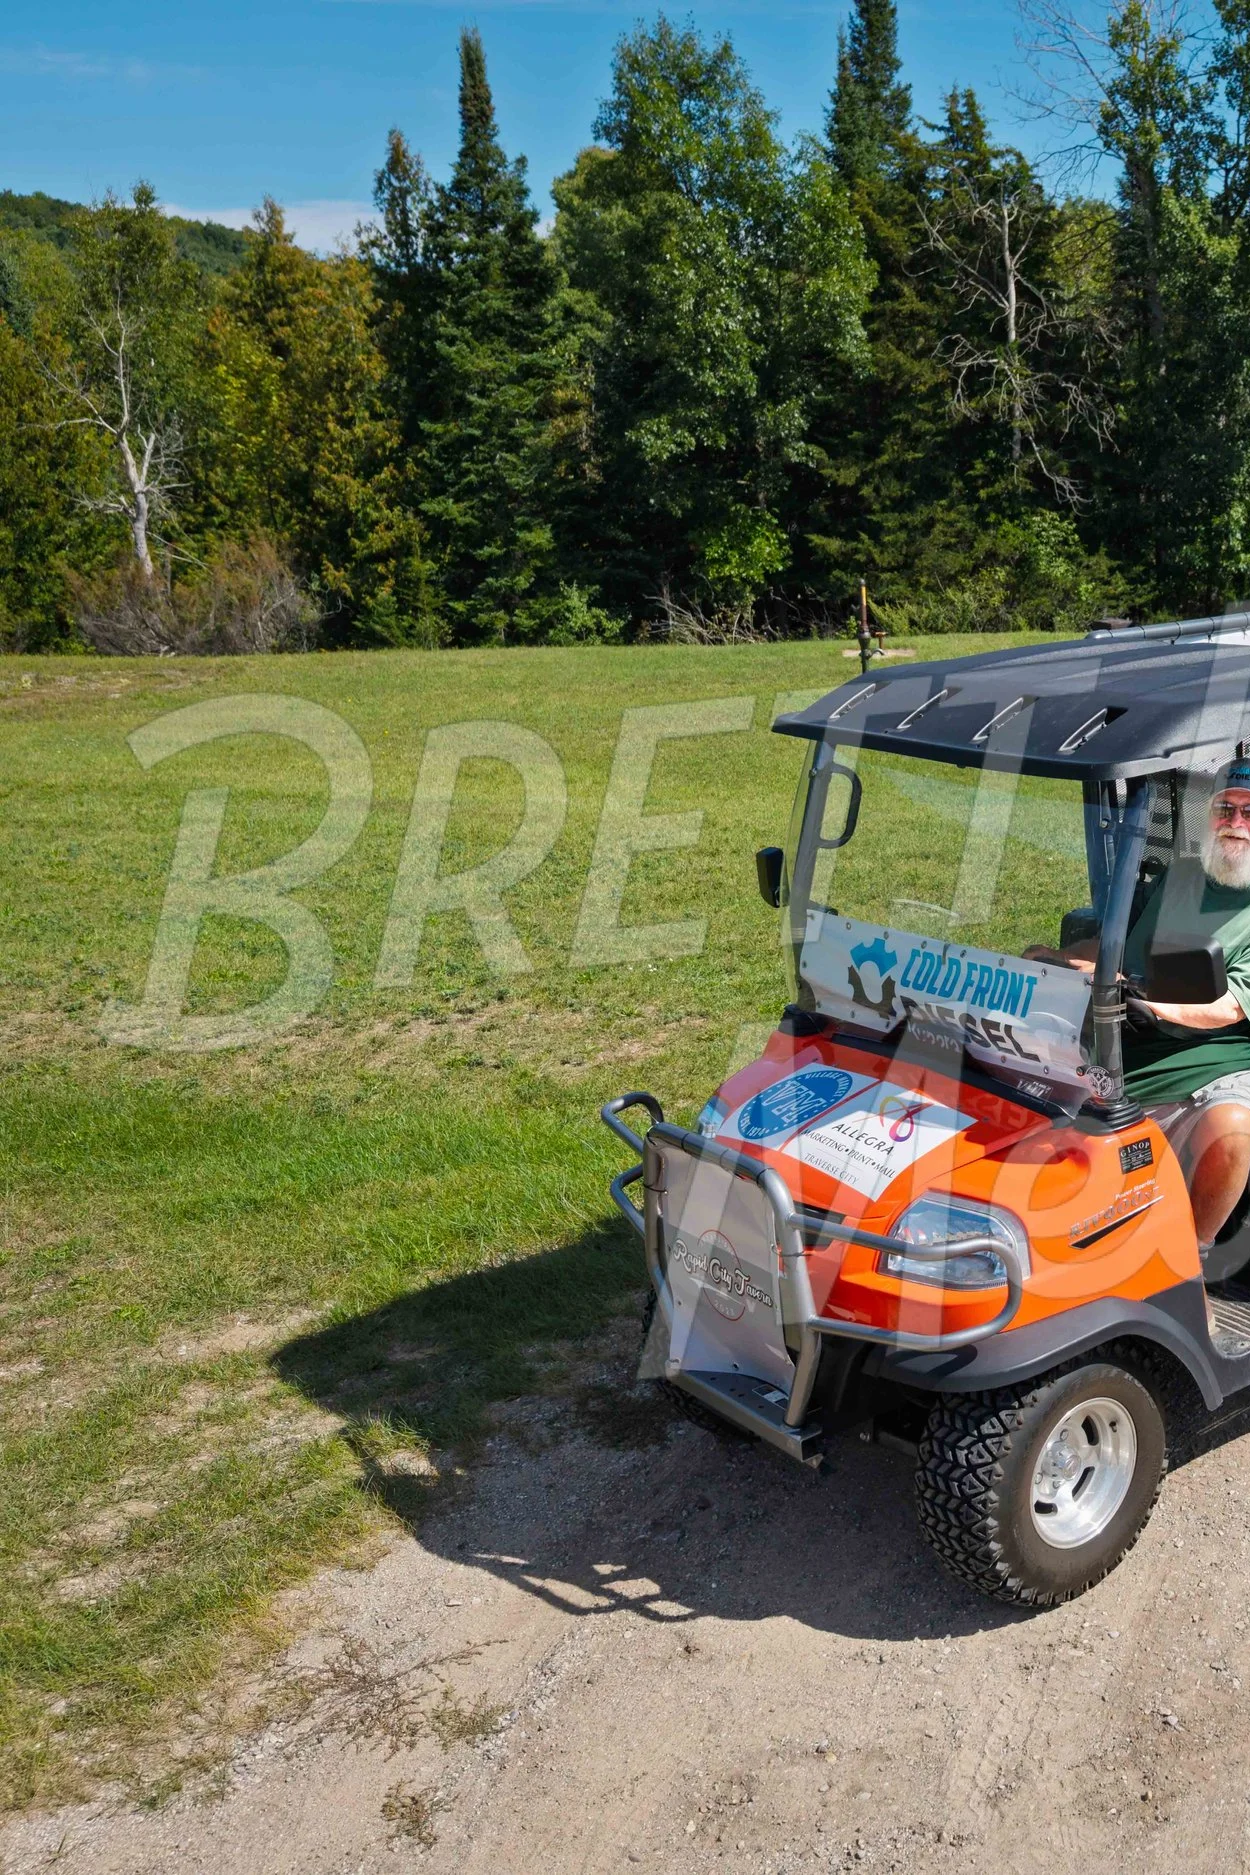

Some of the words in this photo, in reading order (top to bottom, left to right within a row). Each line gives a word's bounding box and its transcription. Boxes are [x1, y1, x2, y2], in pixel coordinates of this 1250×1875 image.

[900, 947, 962, 1001] COLD
[957, 960, 1038, 1019] FRONT
[899, 995, 1042, 1063] DIESEL
[761, 1079, 827, 1124] VM
[800, 1129, 846, 1153] MARKETING
[847, 1149, 873, 1166] PRINT
[873, 1164, 897, 1179] MAIL
[832, 1123, 895, 1155] ALLEGRA
[804, 1153, 840, 1175] TRAVERSE
[839, 1169, 861, 1185] CITY
[673, 1239, 708, 1274] Rapid
[709, 1257, 733, 1292] City
[734, 1268, 774, 1308] Tavern
